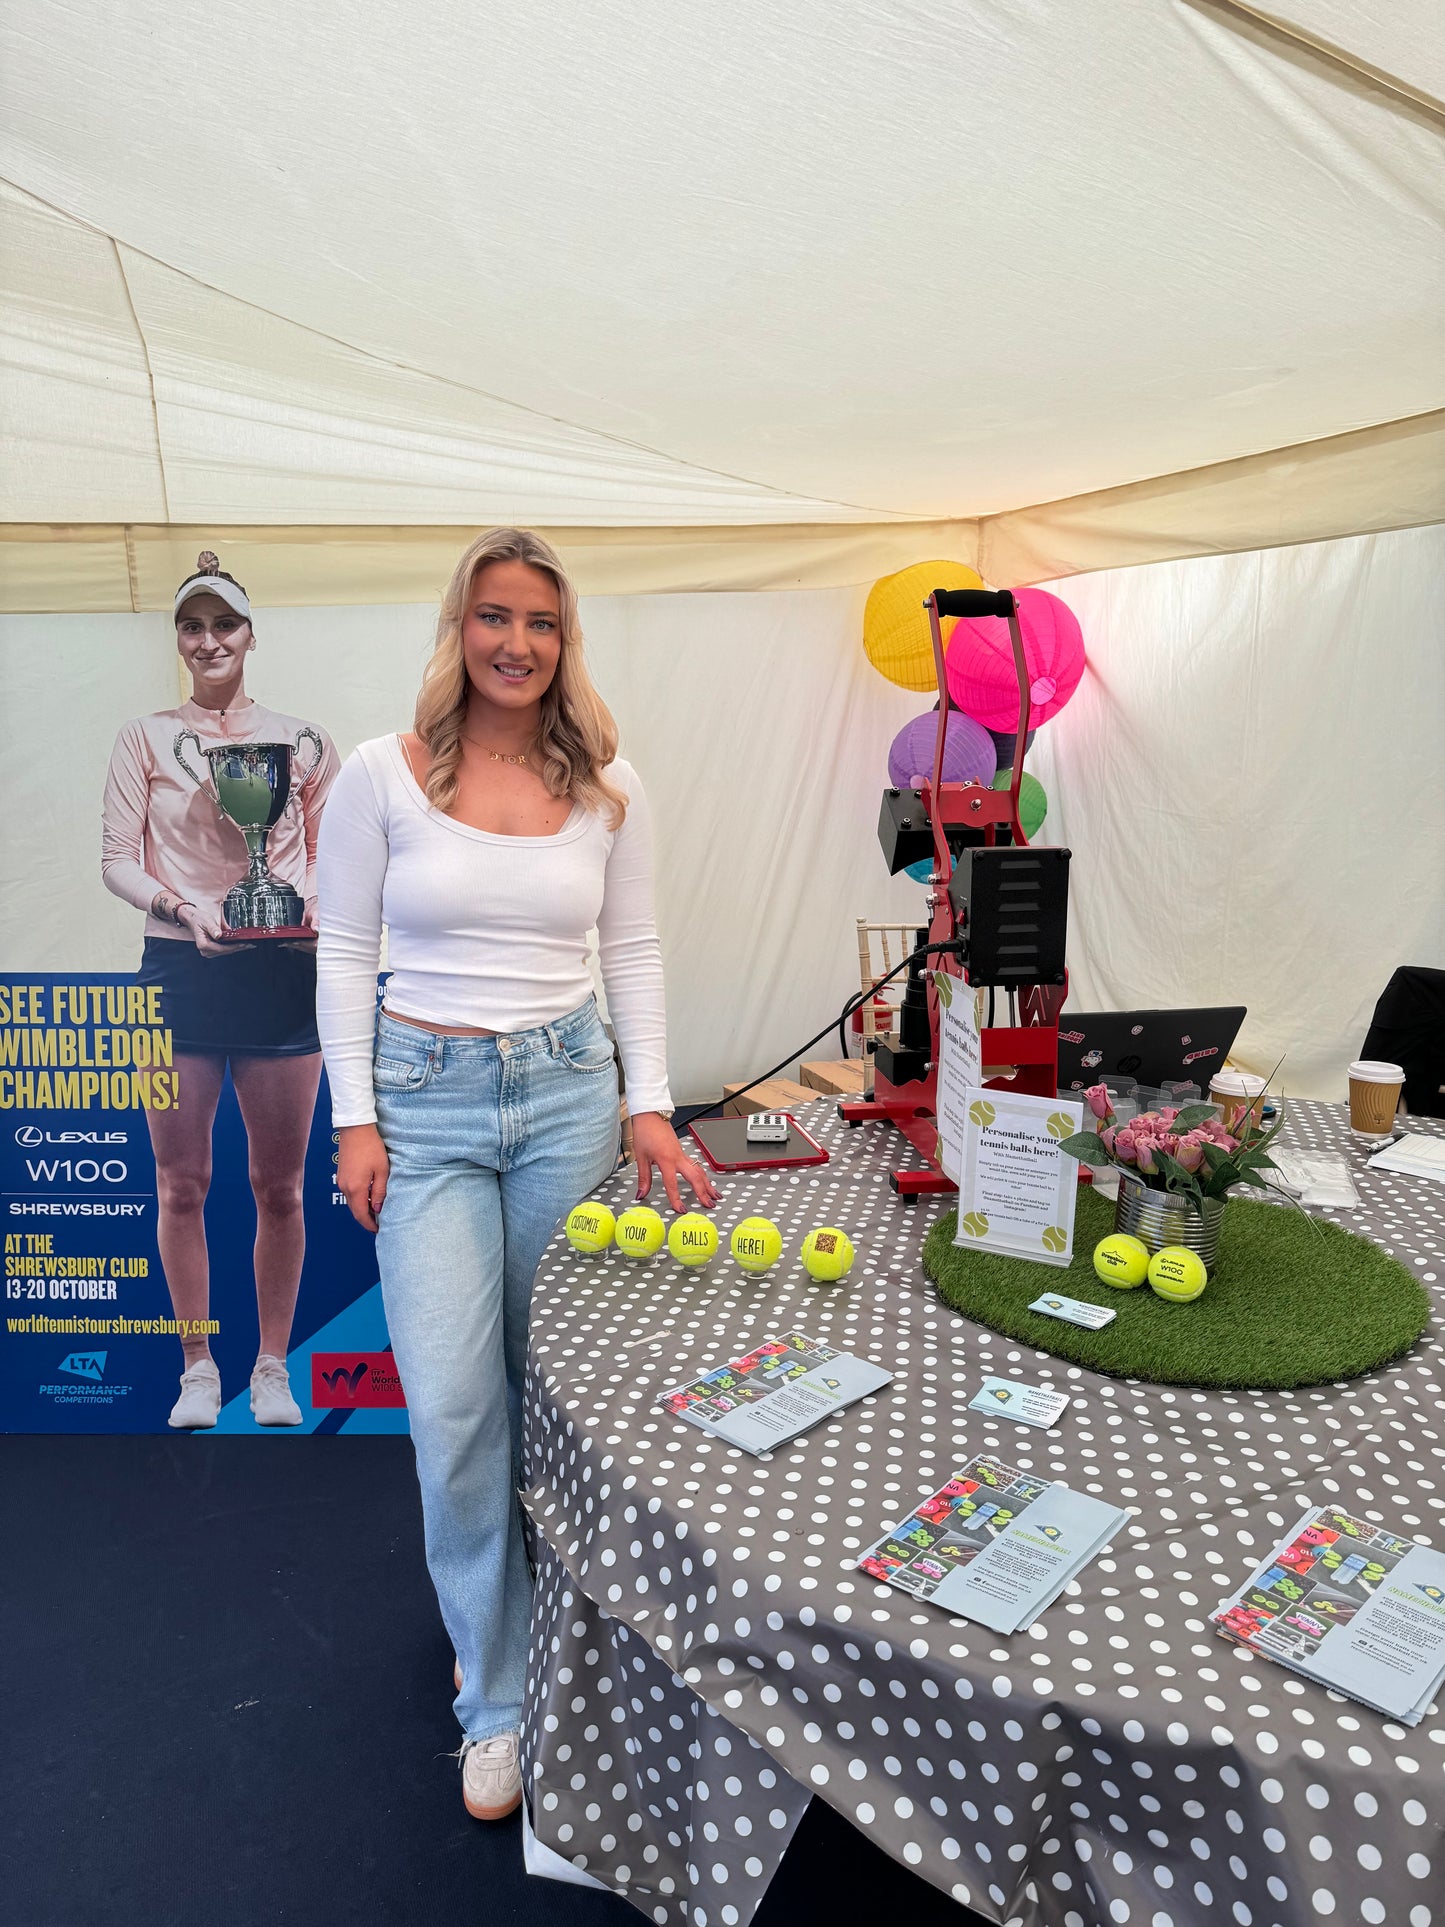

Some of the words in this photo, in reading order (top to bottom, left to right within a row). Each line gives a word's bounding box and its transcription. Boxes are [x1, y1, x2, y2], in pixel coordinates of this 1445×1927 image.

[0, 985, 45, 1024] SEE
[53, 986, 164, 1025] FUTURE
[0, 1028, 173, 1067] WIMBLEDON
[0, 1071, 180, 1110] CHAMPIONS!
[45, 1131, 128, 1144] LEXUS
[982, 1126, 1035, 1141] Personalise
[1036, 1136, 1060, 1145] your
[980, 1139, 1009, 1150] tennis
[1010, 1142, 1032, 1154] balls
[1033, 1146, 1059, 1158] here!
[25, 1160, 128, 1183] W100
[9, 1203, 146, 1216] SHREWSBURY
[4, 1234, 22, 1254] AT
[25, 1234, 54, 1254] THE
[571, 1215, 600, 1235] CUSTOMIZE
[624, 1225, 647, 1243] YOUR
[682, 1231, 709, 1246] BALLS
[737, 1238, 765, 1256] HERE!
[5, 1256, 107, 1277] SHREWSBURY
[110, 1258, 149, 1278] CLUB
[1160, 1264, 1184, 1276] W100
[6, 1279, 46, 1299] 13-20
[50, 1280, 117, 1300] OCTOBER
[7, 1314, 220, 1338] worldtennistourshrewsbury.com
[371, 1375, 400, 1384] World
[54, 1396, 114, 1404] COMPETITIONS
